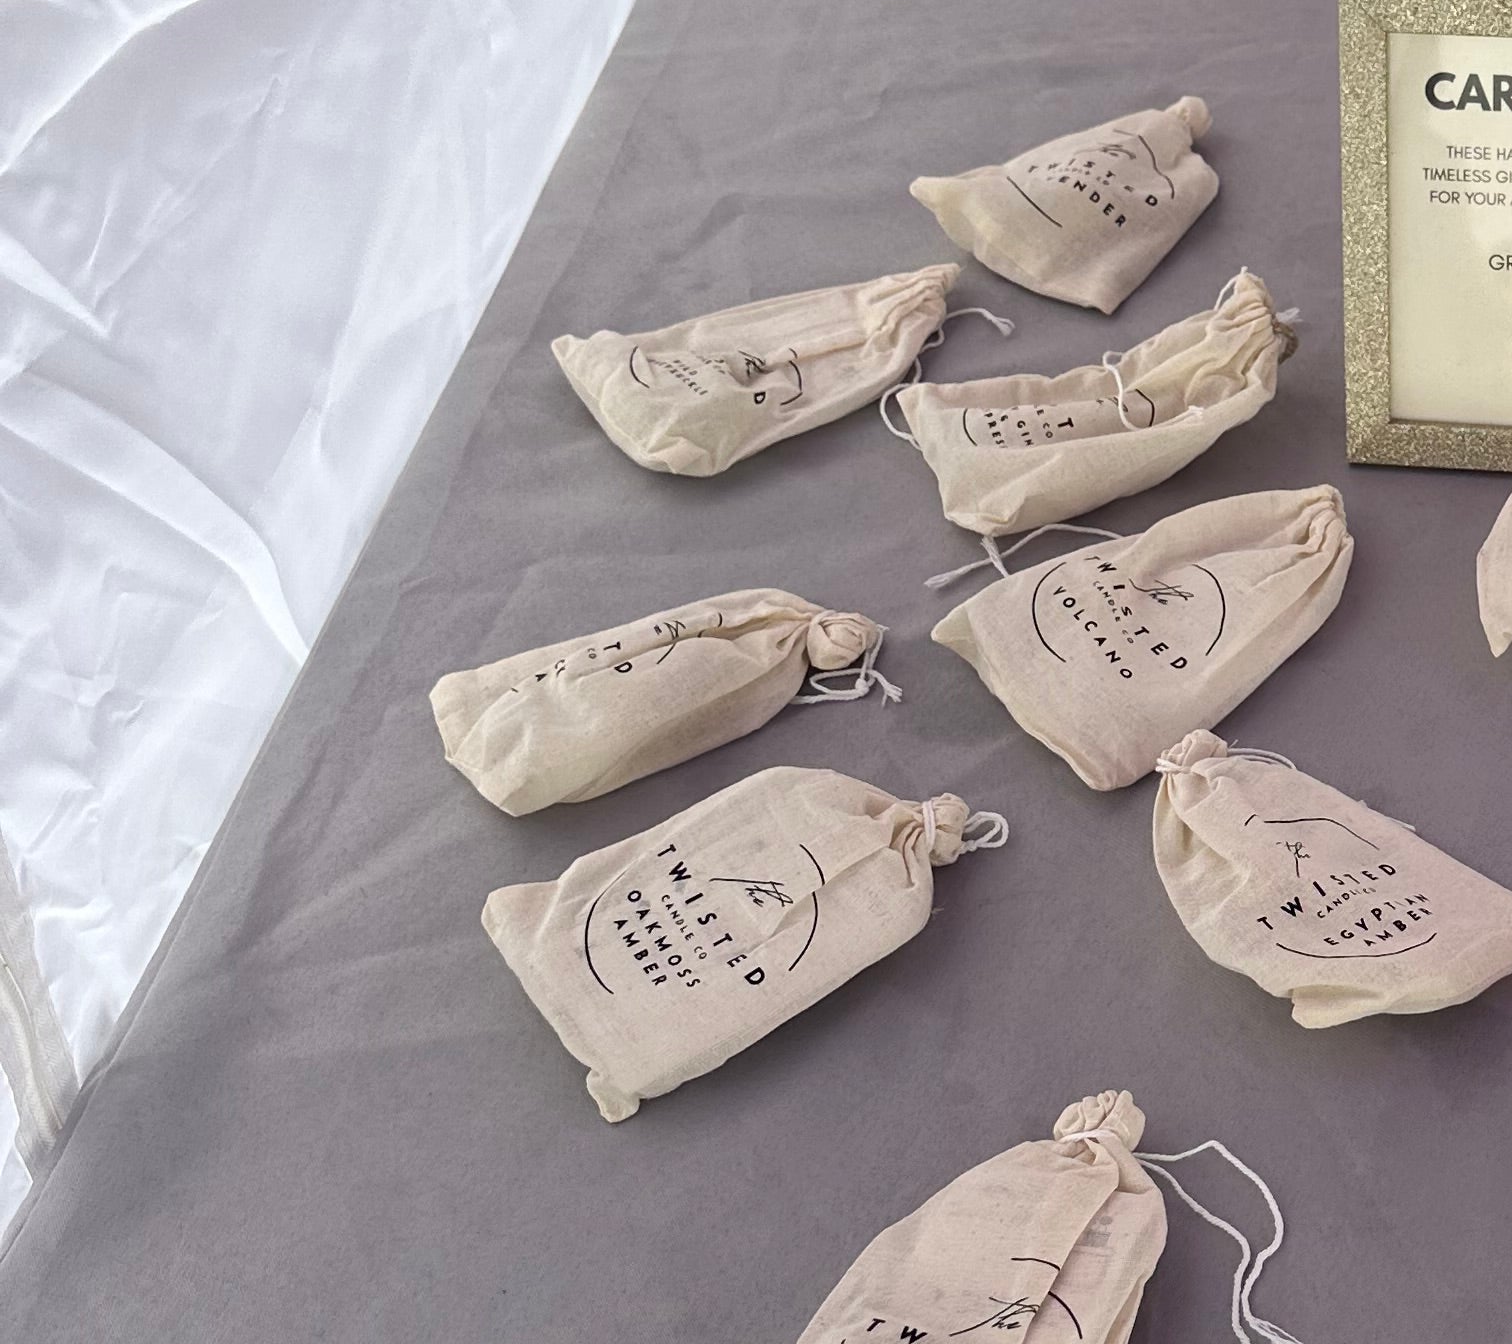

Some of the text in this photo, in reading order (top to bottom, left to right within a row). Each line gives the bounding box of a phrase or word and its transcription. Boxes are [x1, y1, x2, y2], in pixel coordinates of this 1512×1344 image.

[1423, 167, 1491, 185] TIMELESS
[1446, 145, 1492, 161] THESE
[1430, 190, 1460, 205] FOR
[1465, 193, 1506, 207] YOUR
[1053, 586, 1133, 679] VOLCANO
[1084, 556, 1188, 670] TWISTED
[1093, 581, 1134, 644] CANDLE CO
[657, 844, 766, 986] TWISTED
[661, 894, 708, 960] CANDLE CO
[1257, 863, 1397, 931] TWISTED
[1323, 893, 1430, 946] EGYPTIAN
[1363, 907, 1432, 948] AMBER
[613, 919, 668, 987] AMBER
[627, 890, 701, 988] OAKMOSS
